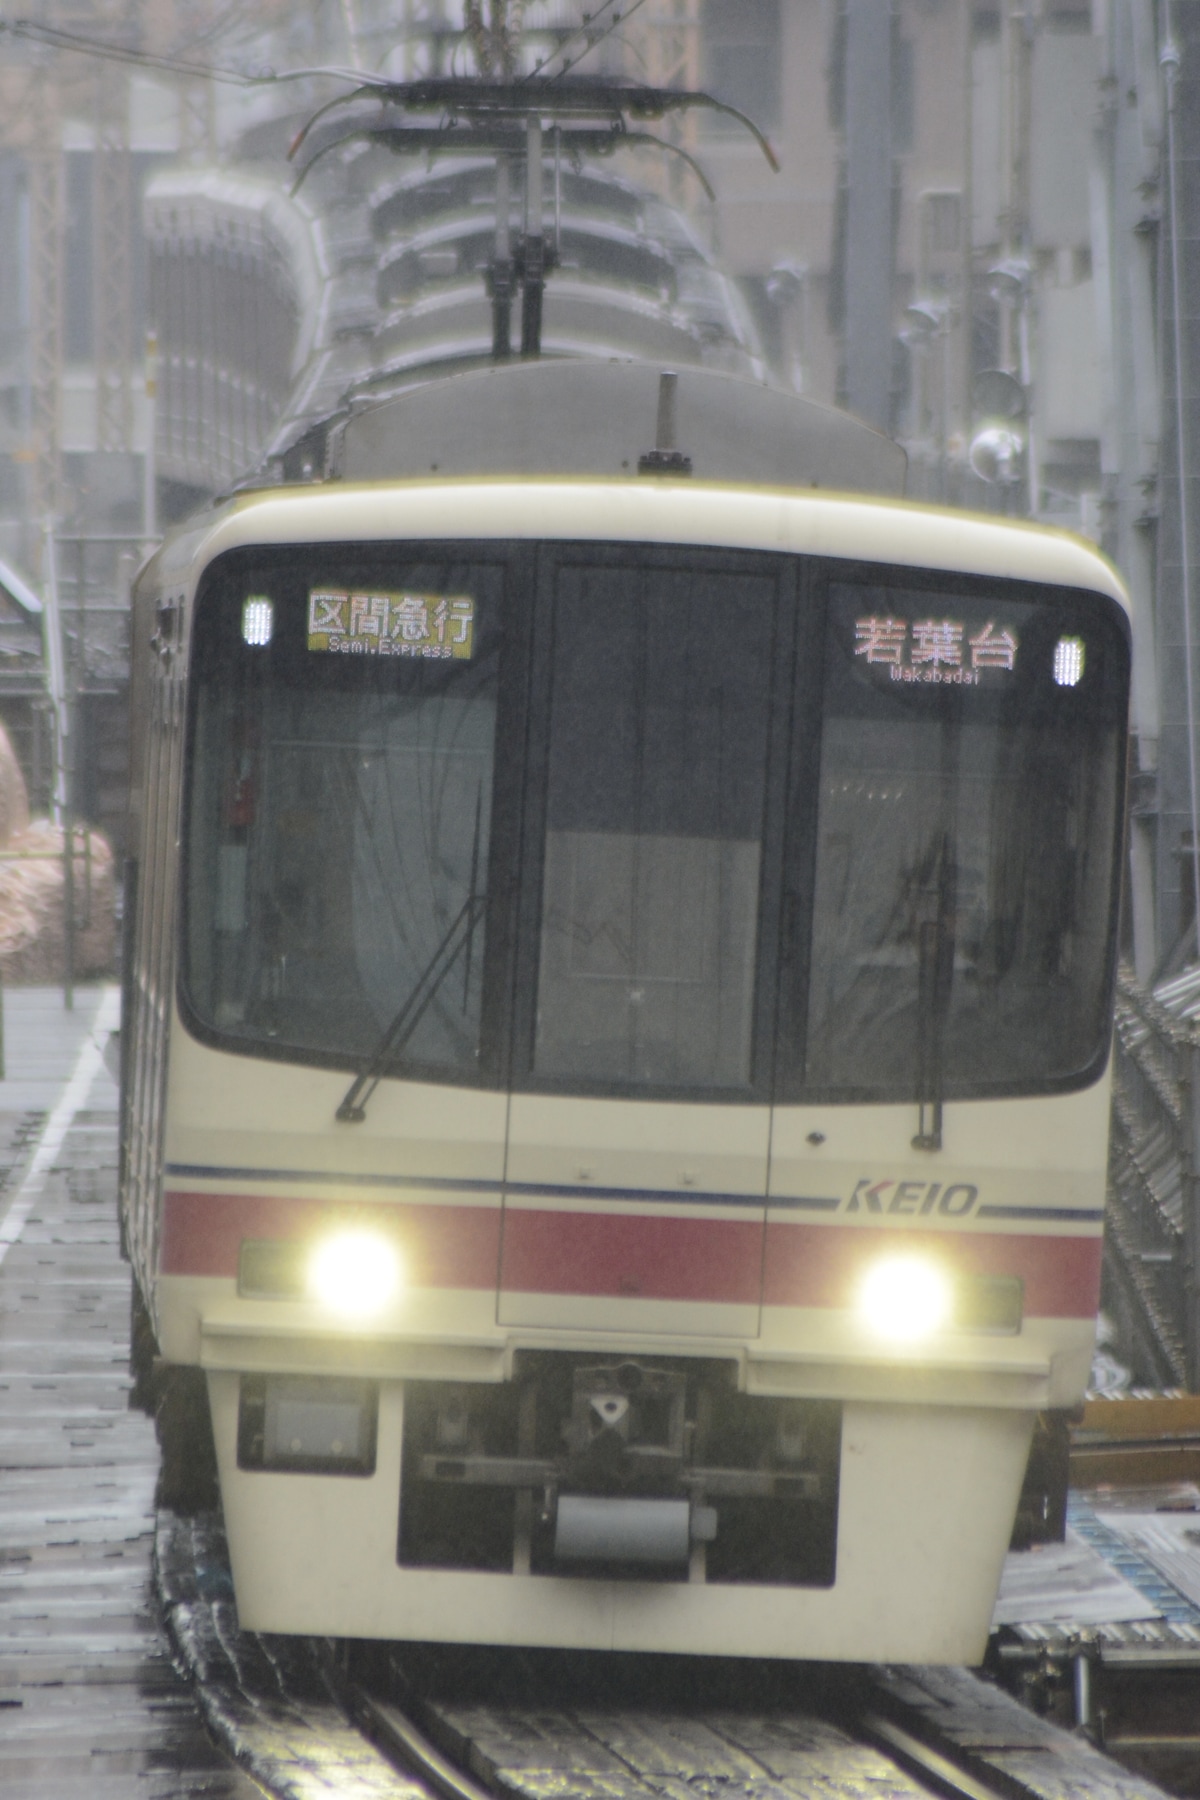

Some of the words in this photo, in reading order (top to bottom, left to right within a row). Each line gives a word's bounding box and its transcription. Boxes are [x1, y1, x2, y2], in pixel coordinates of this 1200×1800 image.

[308, 594, 473, 643] 区間急行
[854, 618, 1018, 670] 若葉台
[890, 664, 979, 686] Wakabadai
[846, 1179, 978, 1216] KEIO
